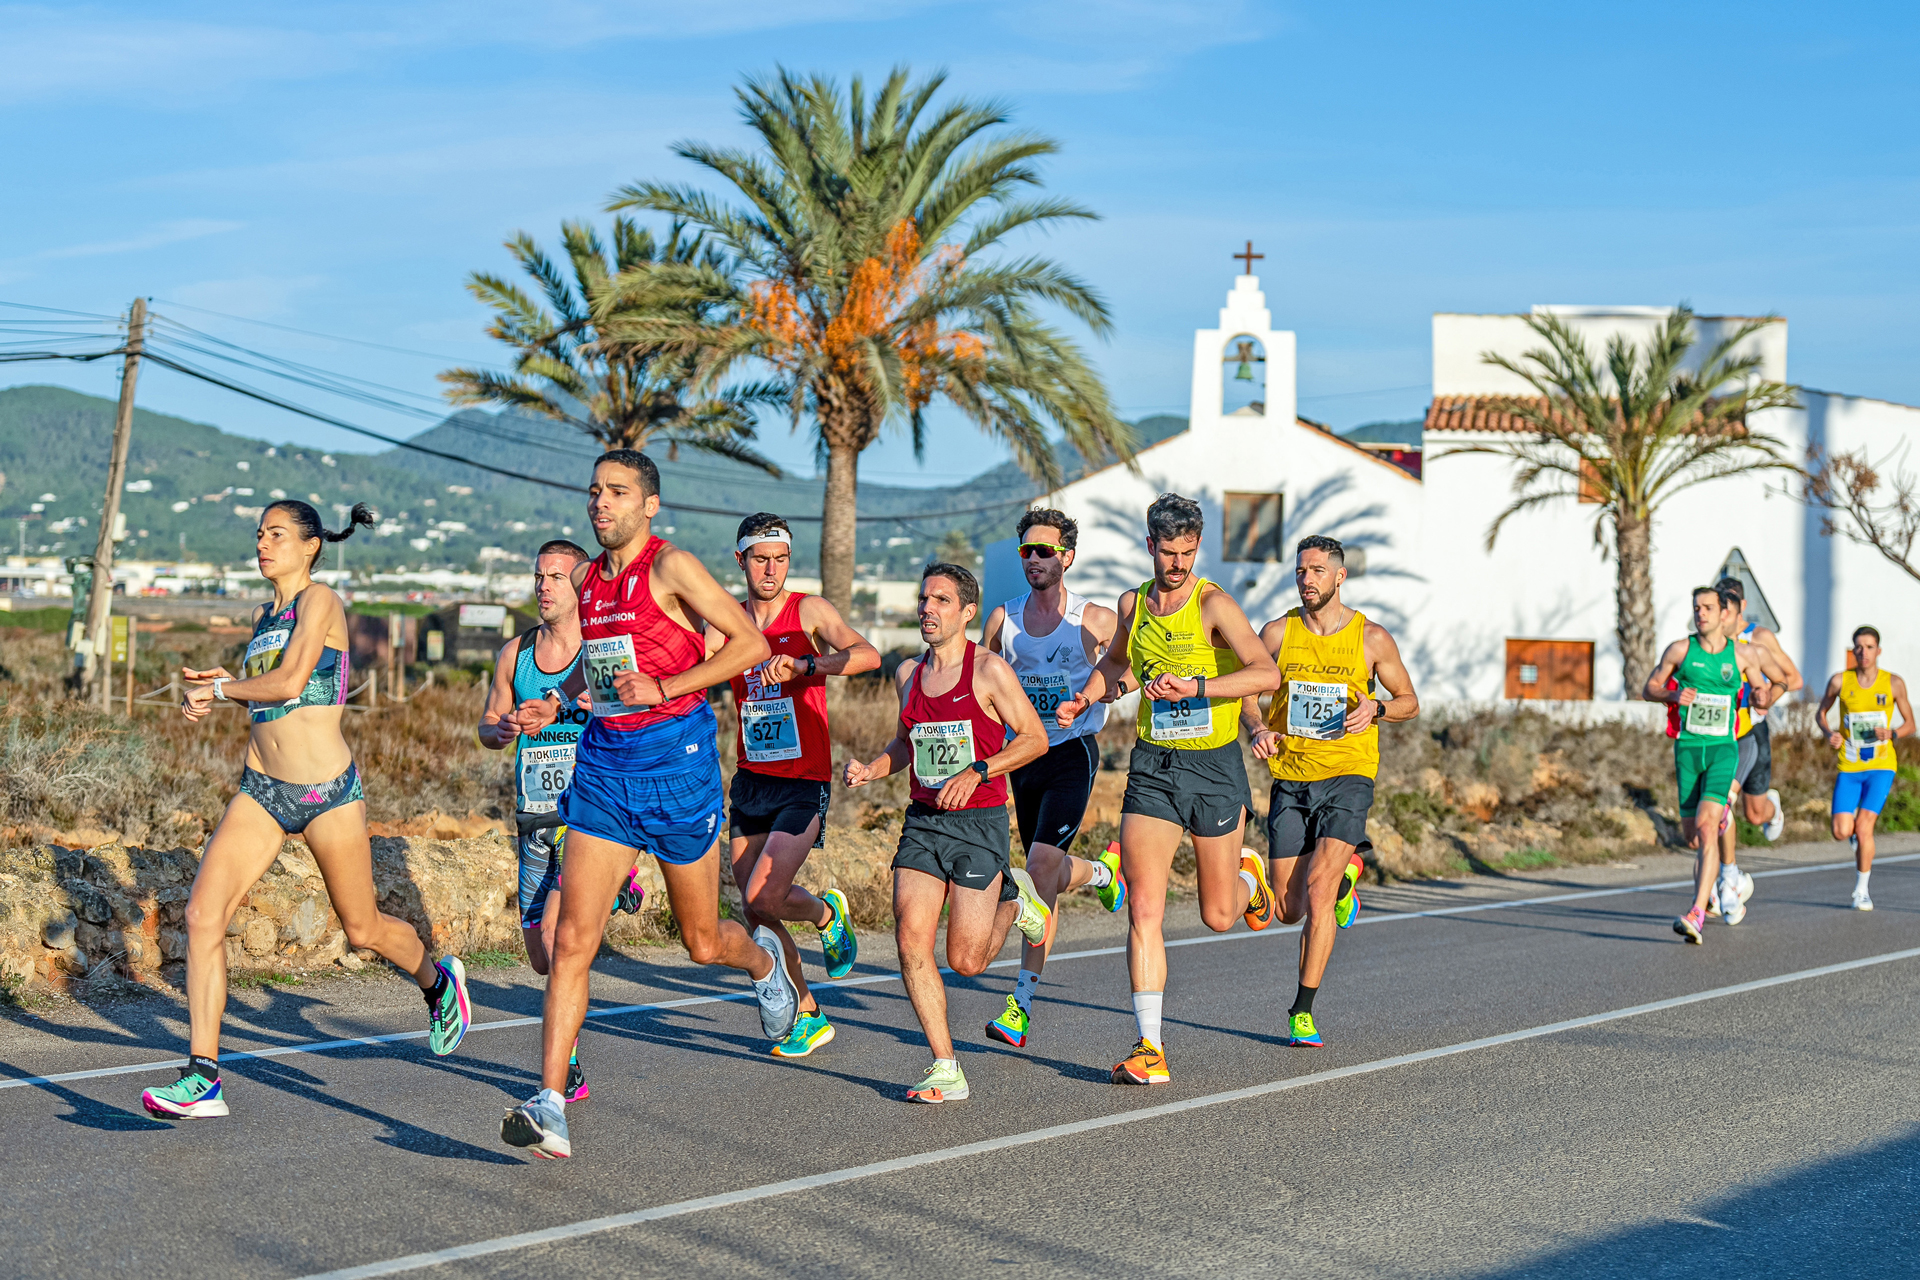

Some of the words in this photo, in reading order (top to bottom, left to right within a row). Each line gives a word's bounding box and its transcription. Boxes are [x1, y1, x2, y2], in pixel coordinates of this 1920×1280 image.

[590, 611, 636, 626] MARATHON
[1028, 693, 1060, 711] 282
[1170, 699, 1191, 718] 58
[1303, 701, 1334, 721] 125
[1173, 719, 1188, 727] RIVERA
[1698, 707, 1722, 721] 215
[753, 721, 782, 741] 527
[928, 743, 960, 765] 122
[541, 769, 566, 791] 86
[836, 919, 852, 951] HOKA
[196, 1058, 218, 1069] adidas
